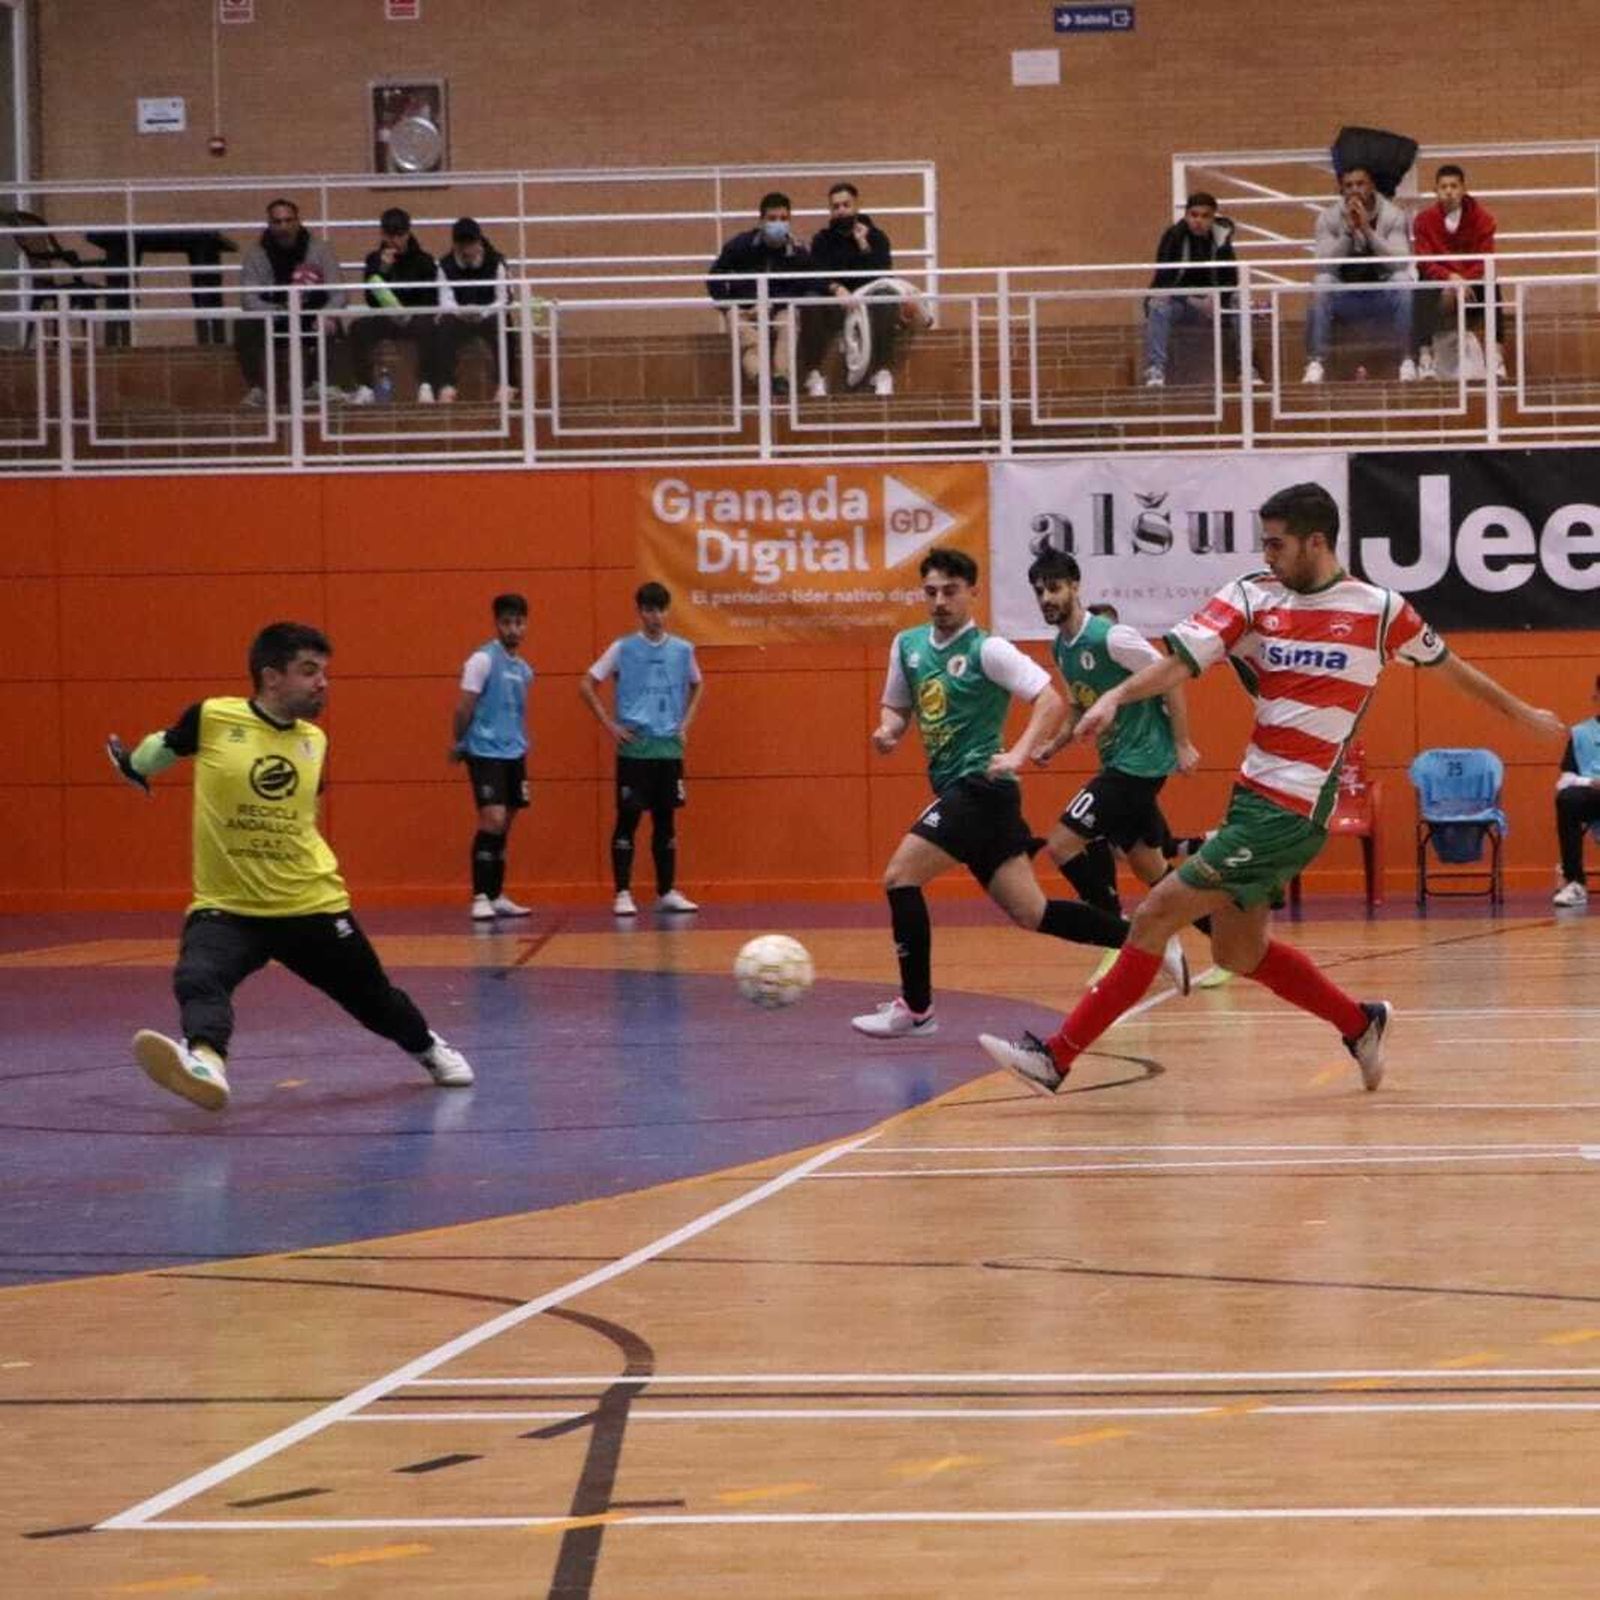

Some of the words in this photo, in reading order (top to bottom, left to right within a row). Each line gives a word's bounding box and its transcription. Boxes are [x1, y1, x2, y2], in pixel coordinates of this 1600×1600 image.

[651, 475, 871, 523] Granada
[889, 508, 934, 533] GD
[1028, 491, 1262, 556] alšu
[1360, 475, 1600, 592] Jee
[696, 526, 871, 584] Digital
[1261, 644, 1348, 670] sima
[1224, 848, 1253, 867] 2
